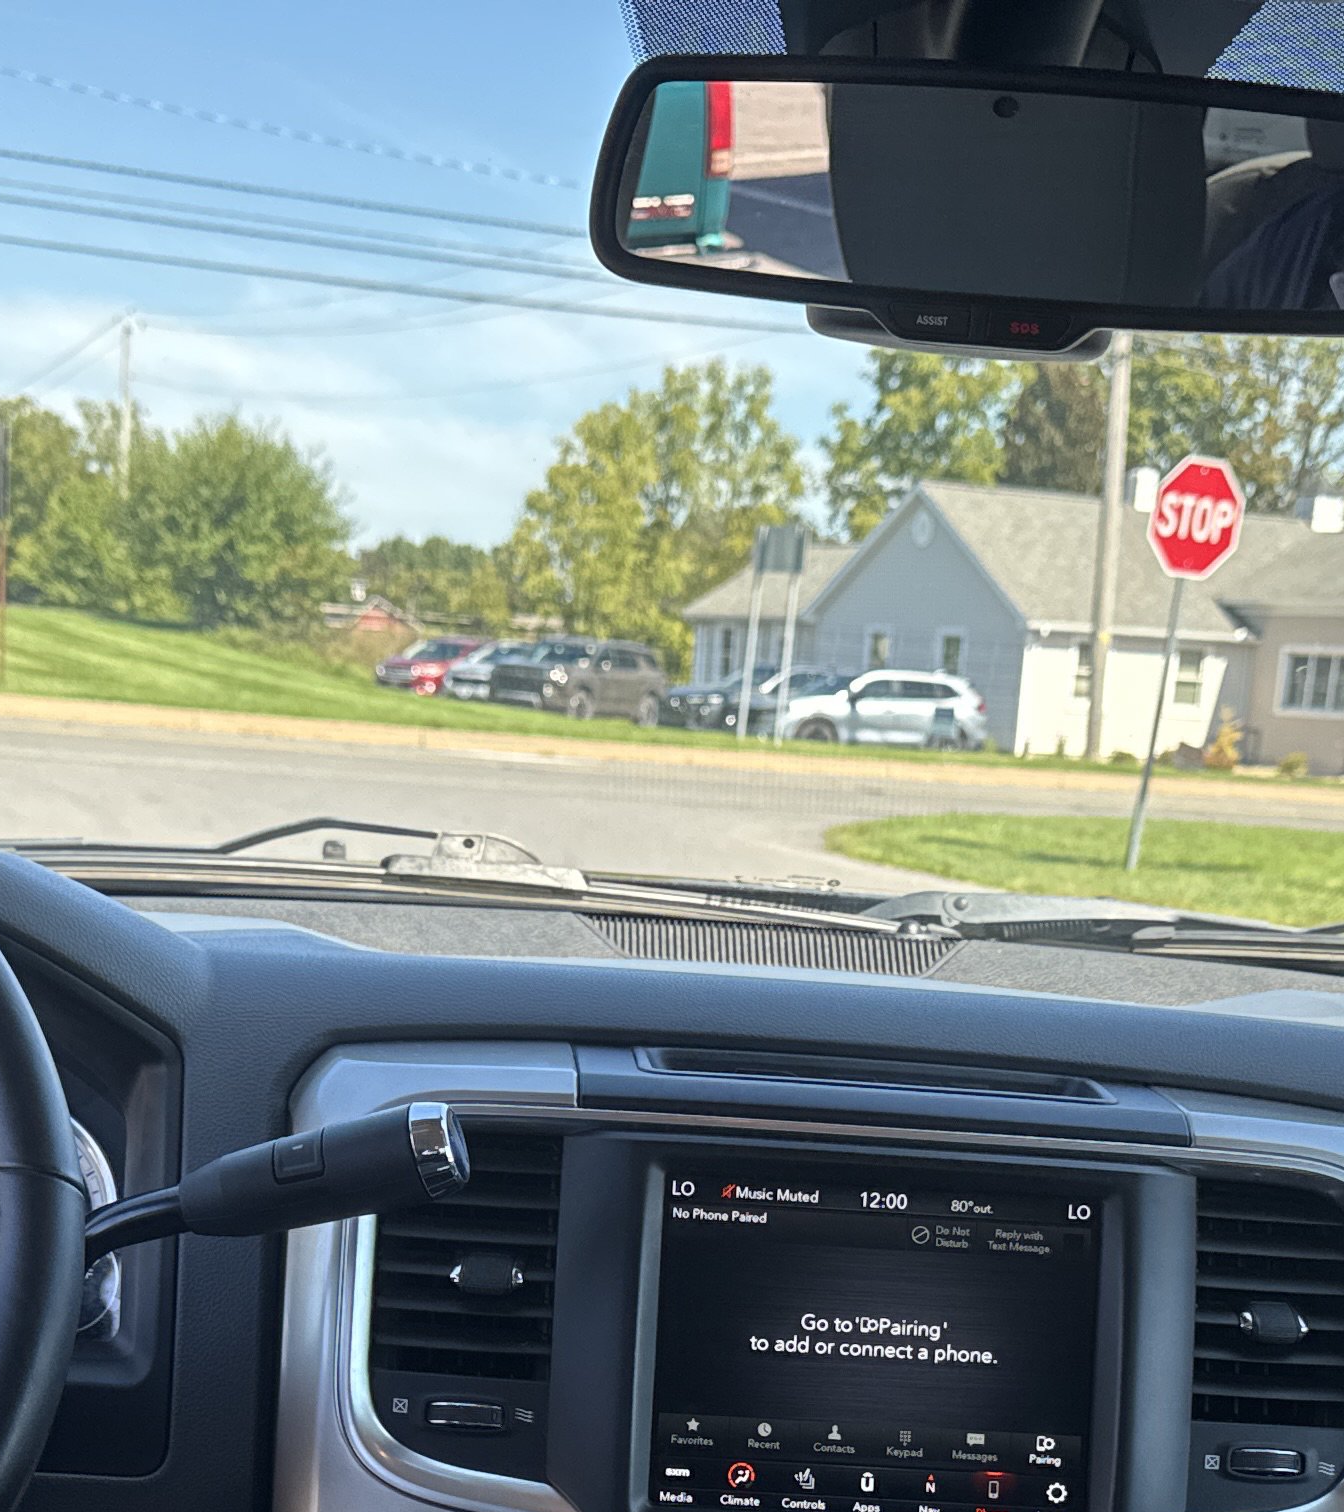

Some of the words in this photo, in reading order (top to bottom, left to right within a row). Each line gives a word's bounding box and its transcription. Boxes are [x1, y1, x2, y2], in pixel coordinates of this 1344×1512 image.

[916, 314, 948, 326] ASSIST
[1010, 321, 1040, 335] SOS
[1156, 491, 1234, 545] STOP
[672, 1180, 695, 1197] LO
[735, 1185, 773, 1201] Music
[777, 1188, 820, 1204] Muted
[860, 1191, 908, 1210] 12:00
[672, 1207, 690, 1219] No
[692, 1209, 729, 1222] Phone
[731, 1210, 768, 1224] Paired
[1068, 1204, 1091, 1220] LO
[935, 1225, 949, 1236] Do
[952, 1226, 970, 1237] Not
[995, 1229, 1021, 1242] Reply
[1023, 1231, 1044, 1242] with
[935, 1238, 969, 1249] Disturb
[987, 1240, 1007, 1251] Text
[1009, 1241, 1051, 1255] Message
[801, 1313, 829, 1331] Go
[834, 1317, 853, 1333] to
[750, 1335, 769, 1351] to
[774, 1335, 810, 1353] add
[814, 1341, 835, 1355] or
[839, 1341, 914, 1360] connect
[917, 1348, 929, 1361] a
[934, 1344, 998, 1365] phone.
[670, 1434, 714, 1447] Favorites
[747, 1438, 781, 1450] Recent
[813, 1442, 856, 1455] Contacts
[886, 1446, 924, 1459] Keypad
[952, 1450, 999, 1463] Messages
[1028, 1453, 1062, 1468] Pairing
[659, 1491, 694, 1504] Media
[720, 1494, 761, 1508] Climate
[781, 1497, 826, 1511] Controls
